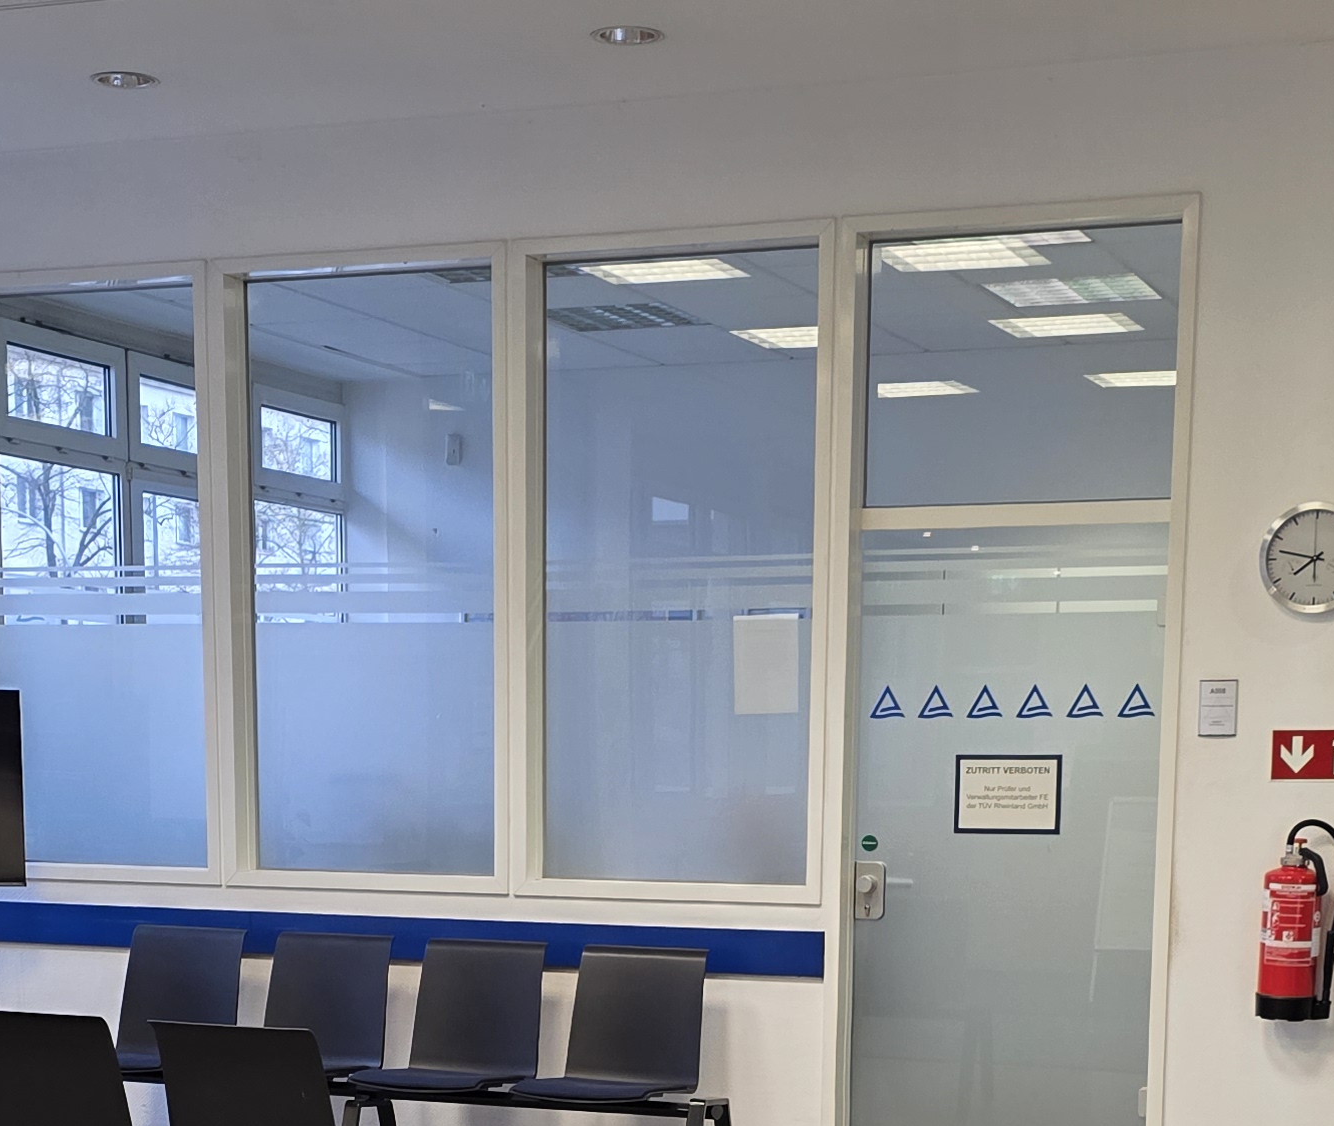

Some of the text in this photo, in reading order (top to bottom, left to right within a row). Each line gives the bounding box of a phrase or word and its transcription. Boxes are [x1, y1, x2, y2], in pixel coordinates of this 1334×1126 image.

[965, 766, 1050, 774] ZUTRITT VERBOTEN
[993, 802, 1026, 810] Rheinland
[1027, 802, 1048, 810] GmbH
